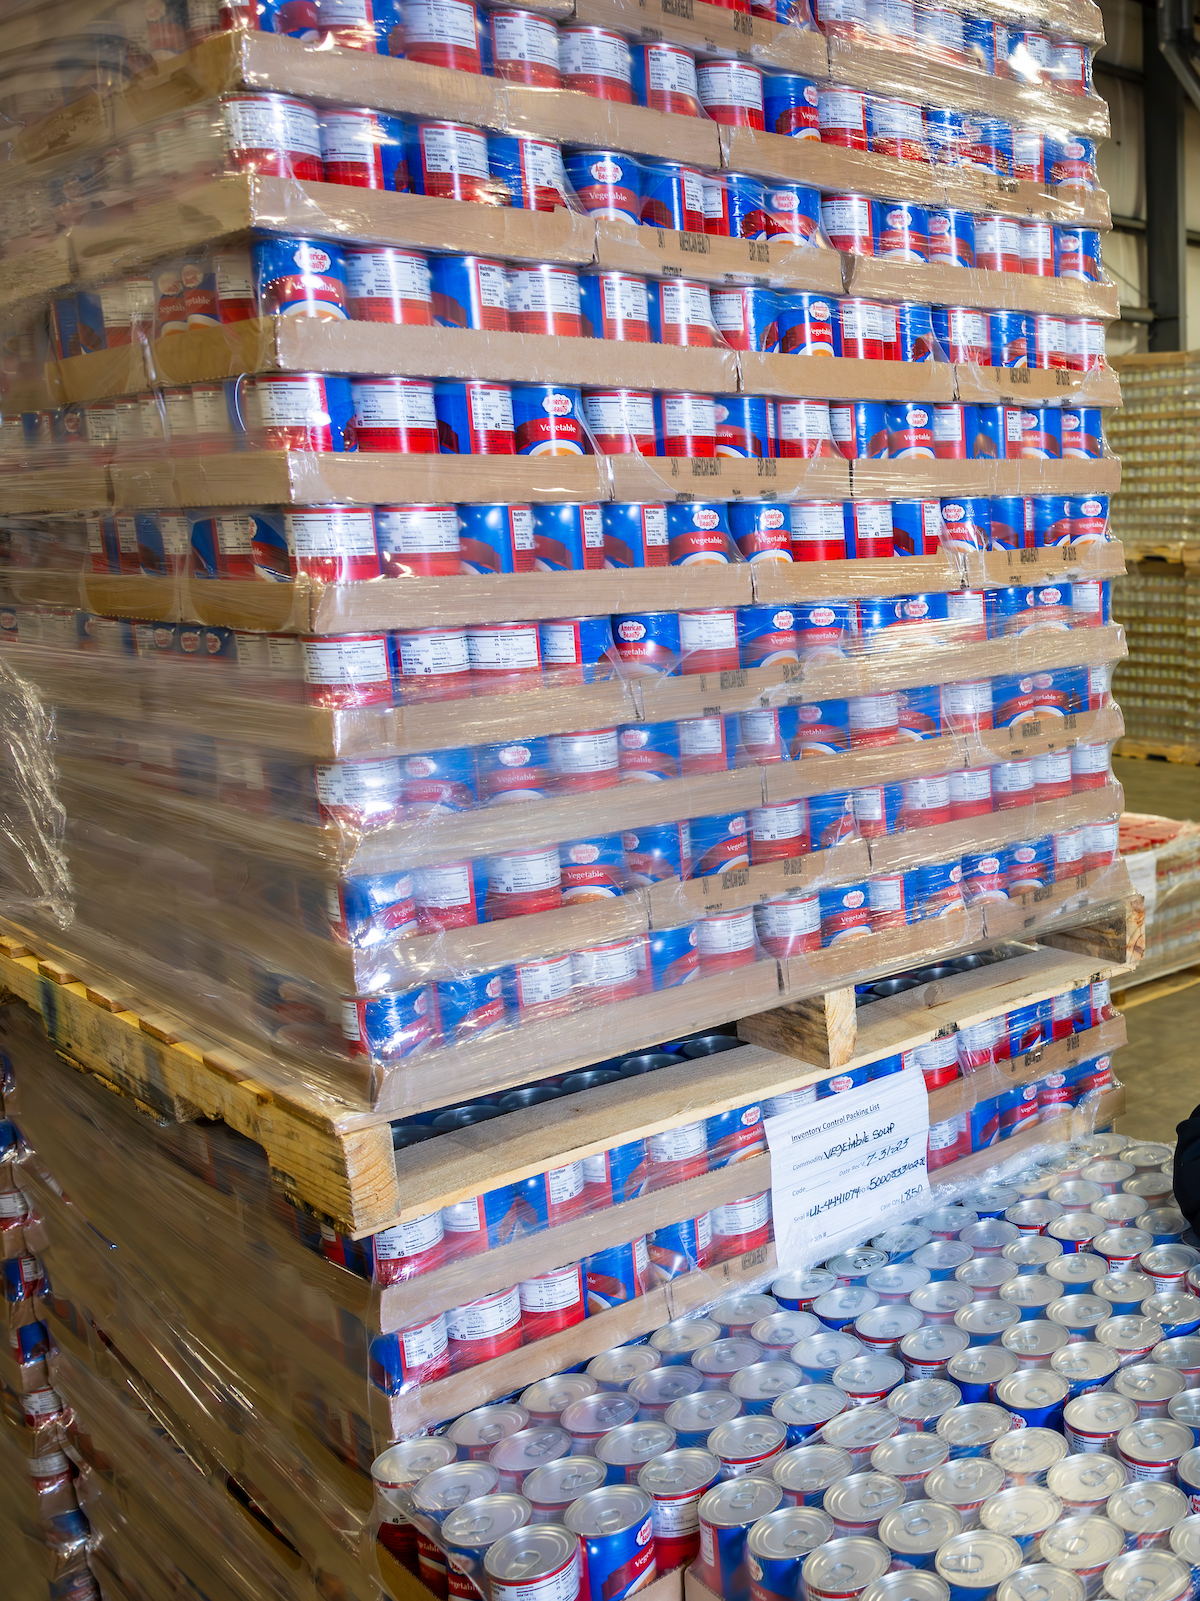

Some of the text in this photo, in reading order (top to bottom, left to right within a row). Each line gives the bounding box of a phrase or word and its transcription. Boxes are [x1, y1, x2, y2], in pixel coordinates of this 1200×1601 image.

[595, 163, 619, 175] American
[589, 191, 627, 202] Vegetable
[540, 424, 576, 433] Vegetable
[903, 434, 931, 442] Vegetable
[943, 505, 963, 515] American
[695, 512, 717, 522] American
[690, 536, 723, 545] Vegetable
[757, 534, 788, 543] Vegetable
[811, 610, 834, 620] American
[620, 624, 642, 635] American
[623, 631, 641, 640] Beauty
[807, 631, 839, 640] Vegetable
[567, 871, 604, 880] Vegetable
[840, 912, 868, 923] Vegetable
[1043, 1090, 1068, 1100] Vegetable
[791, 1103, 880, 1141] Inventory Control Packing List
[793, 1154, 823, 1171] Commodity
[792, 1186, 806, 1196] Code
[794, 1212, 804, 1223] Seal
